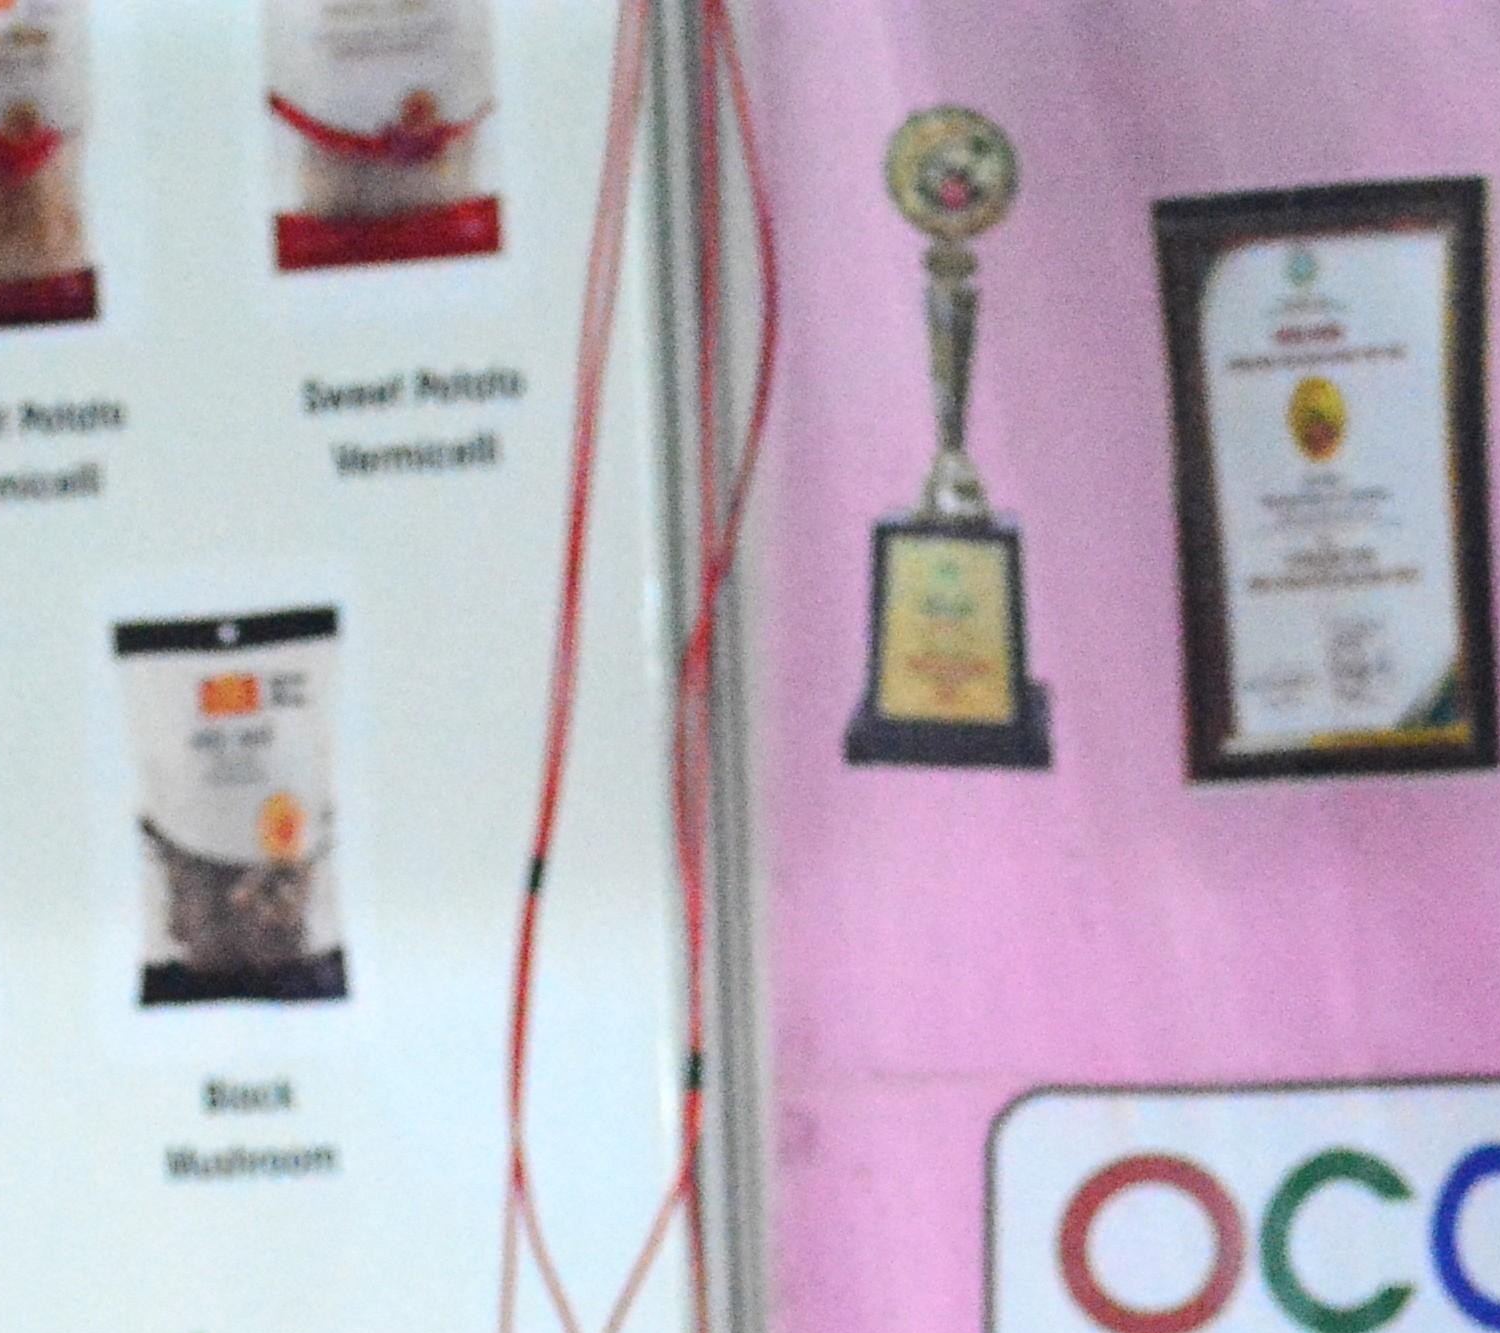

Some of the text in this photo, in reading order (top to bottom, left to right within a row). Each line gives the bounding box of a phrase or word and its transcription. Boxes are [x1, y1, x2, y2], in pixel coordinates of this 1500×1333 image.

[302, 367, 527, 415] Sweet Potato
[18, 397, 127, 432] Potato
